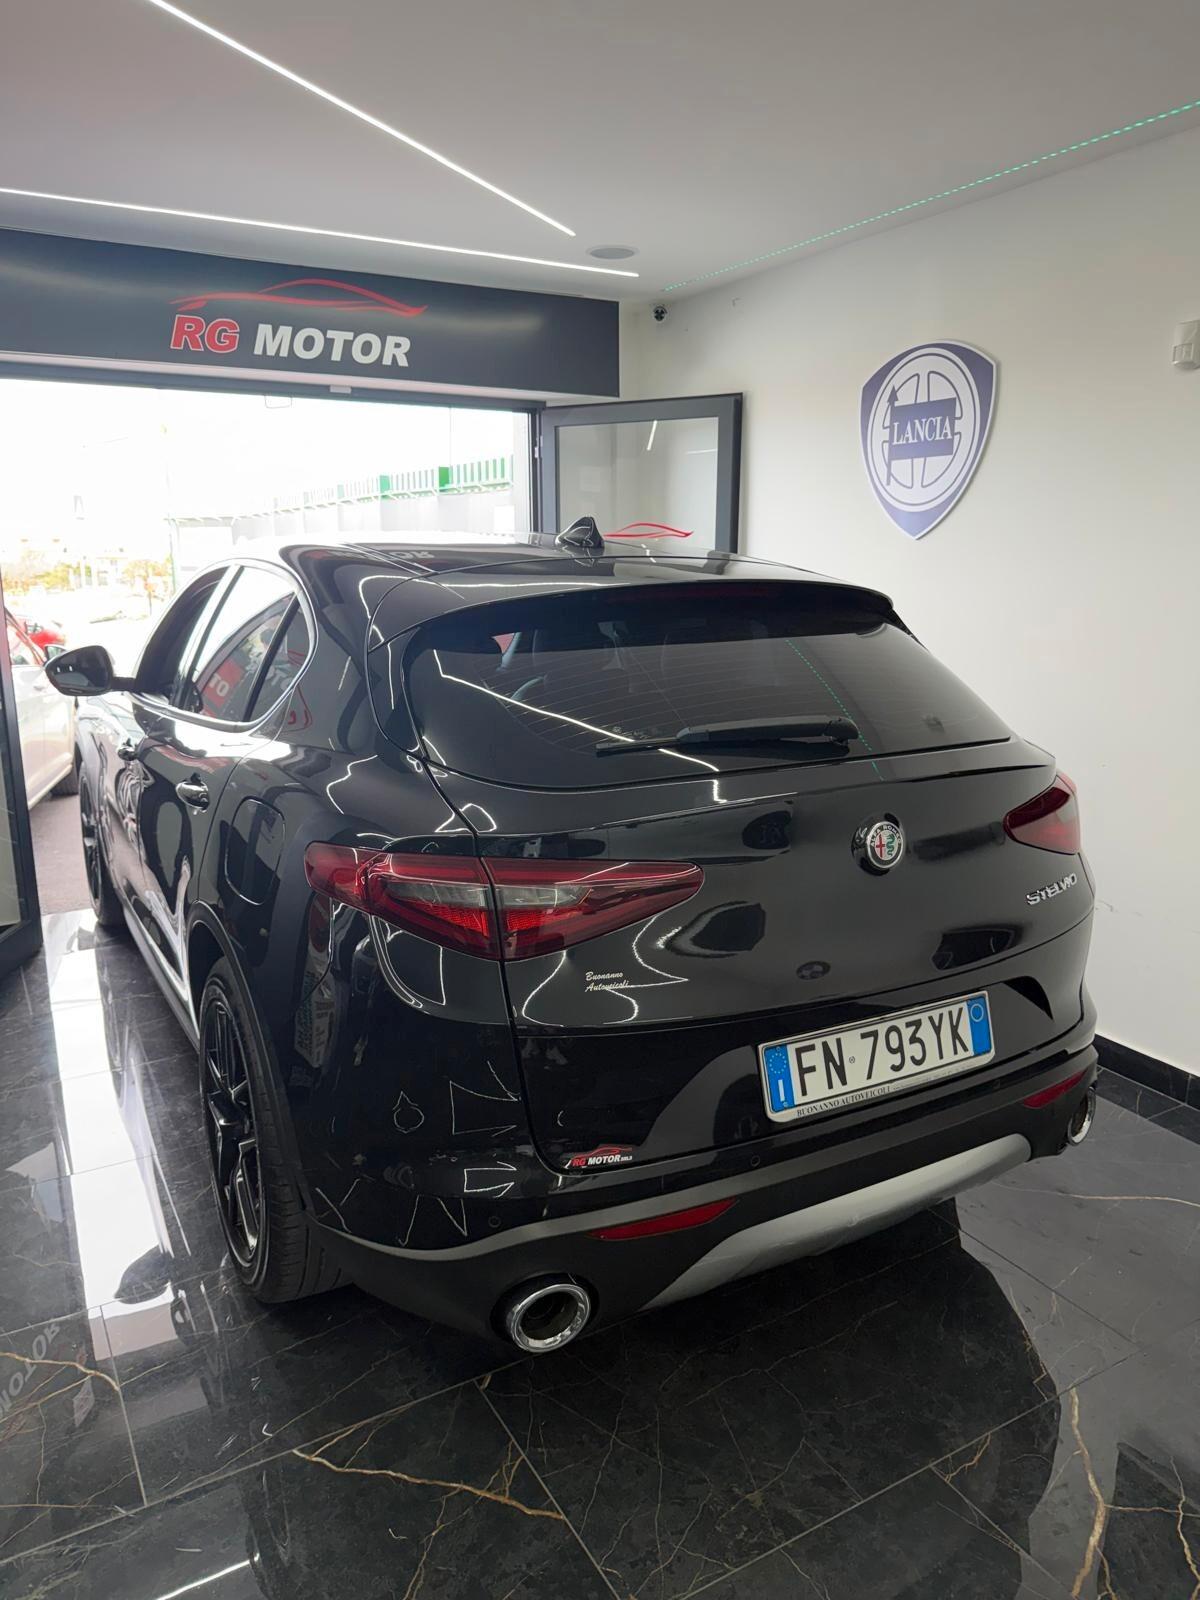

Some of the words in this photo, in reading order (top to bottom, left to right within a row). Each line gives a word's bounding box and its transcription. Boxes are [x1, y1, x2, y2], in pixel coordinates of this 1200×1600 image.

[170, 314, 240, 354] RG
[253, 323, 411, 367] MOTOR
[892, 416, 953, 446] LANCIA
[585, 971, 624, 981] Buonanno
[794, 1037, 848, 1097] FN
[860, 1006, 969, 1081] 793YK
[572, 1158, 586, 1167] RG
[587, 1154, 621, 1166] MOTOR
